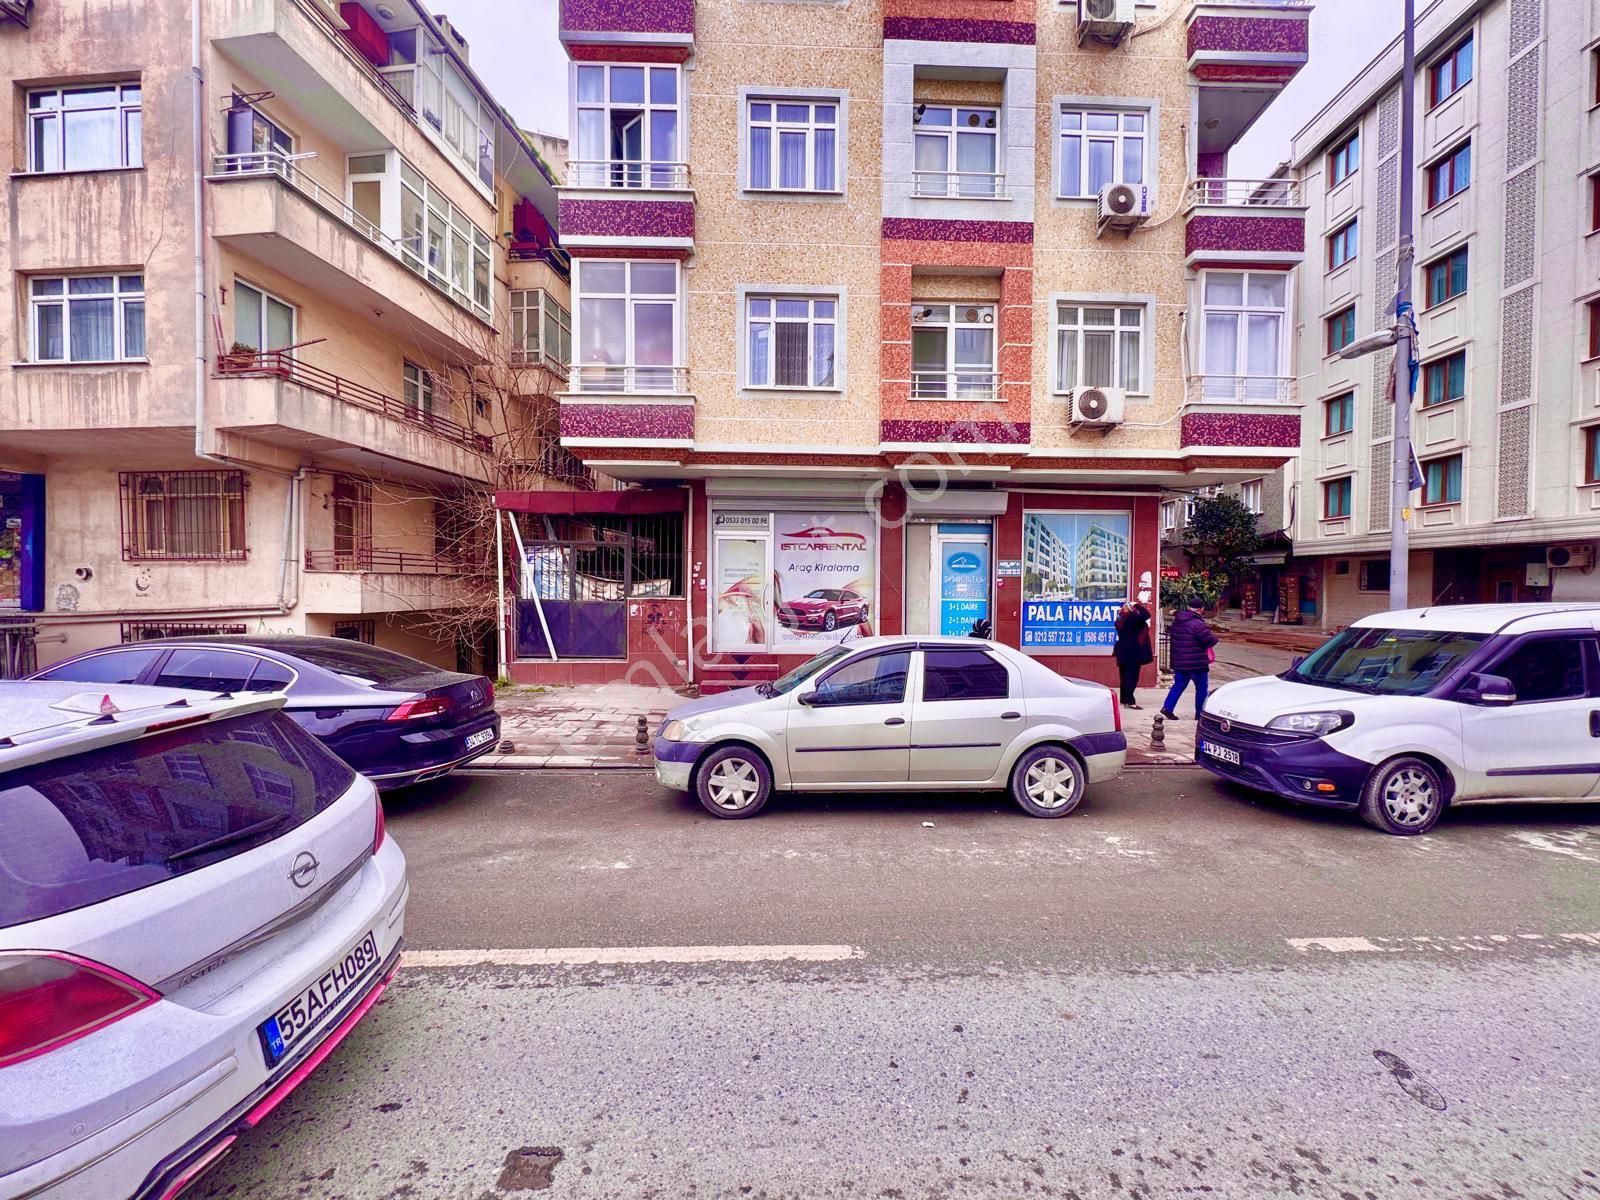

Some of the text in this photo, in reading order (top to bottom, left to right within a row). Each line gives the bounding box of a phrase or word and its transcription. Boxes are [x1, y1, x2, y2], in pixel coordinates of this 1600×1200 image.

[788, 563, 860, 573] Araç Kiralama
[1028, 605, 1064, 621] PALA
[271, 1037, 283, 1050] TR
